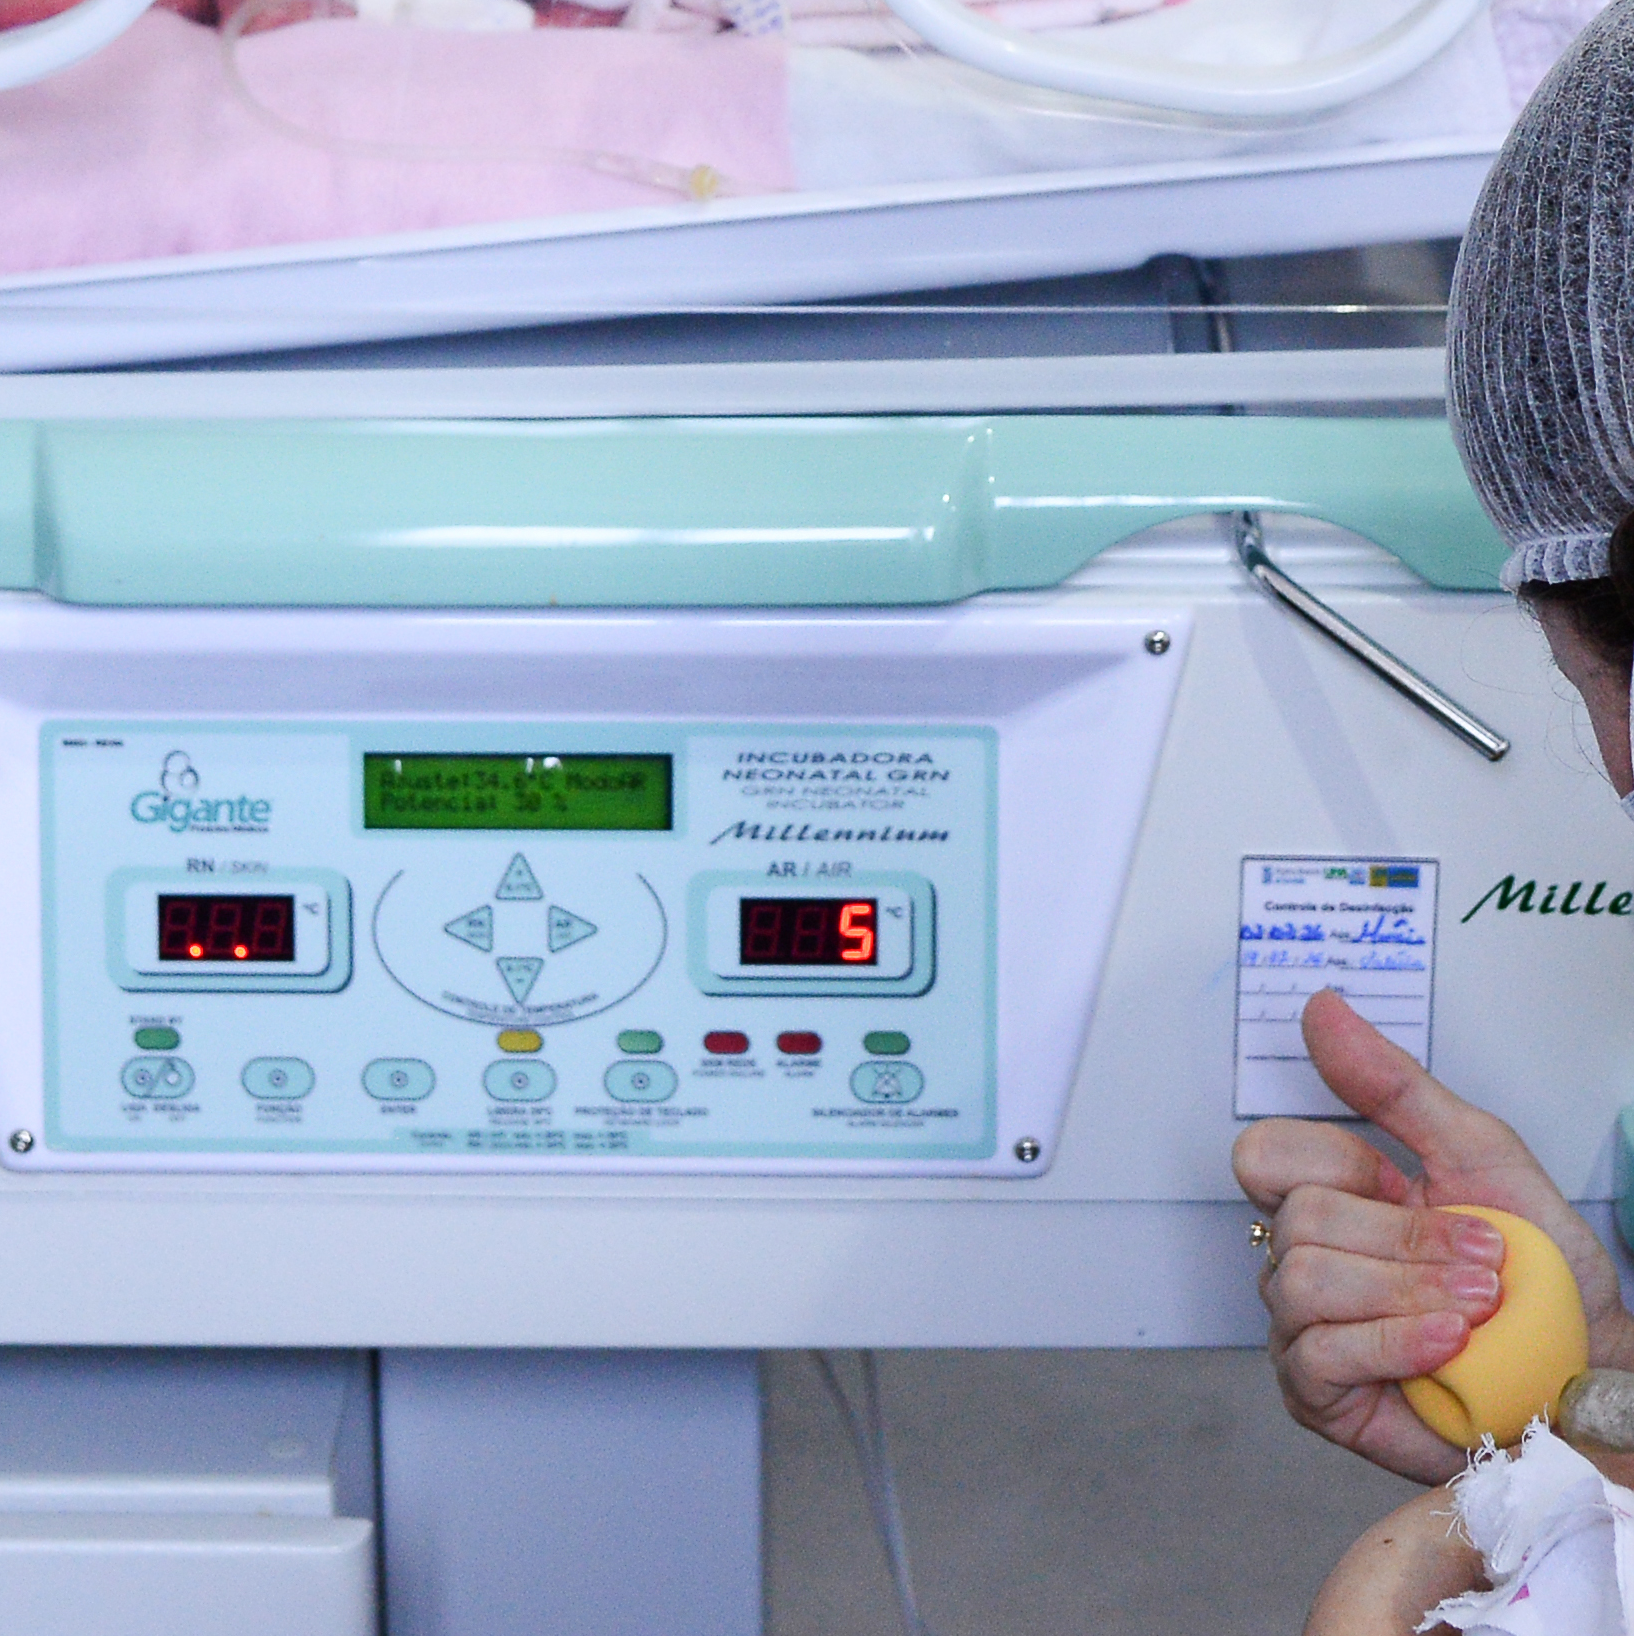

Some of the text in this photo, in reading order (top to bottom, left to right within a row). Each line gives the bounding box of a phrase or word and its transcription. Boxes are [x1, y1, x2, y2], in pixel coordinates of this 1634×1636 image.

[736, 752, 934, 765] INCUBADORA
[722, 768, 951, 782] NEONATAL GRN
[741, 785, 930, 797] GRN NEONATAL
[131, 791, 272, 833] Gigante
[765, 799, 905, 811] INCUBATOR
[709, 820, 950, 845] Millennium
[187, 857, 215, 873] RN
[766, 861, 797, 877] AR
[815, 861, 853, 877] AIR
[1264, 901, 1317, 911] Controle
[838, 903, 875, 960] 5
